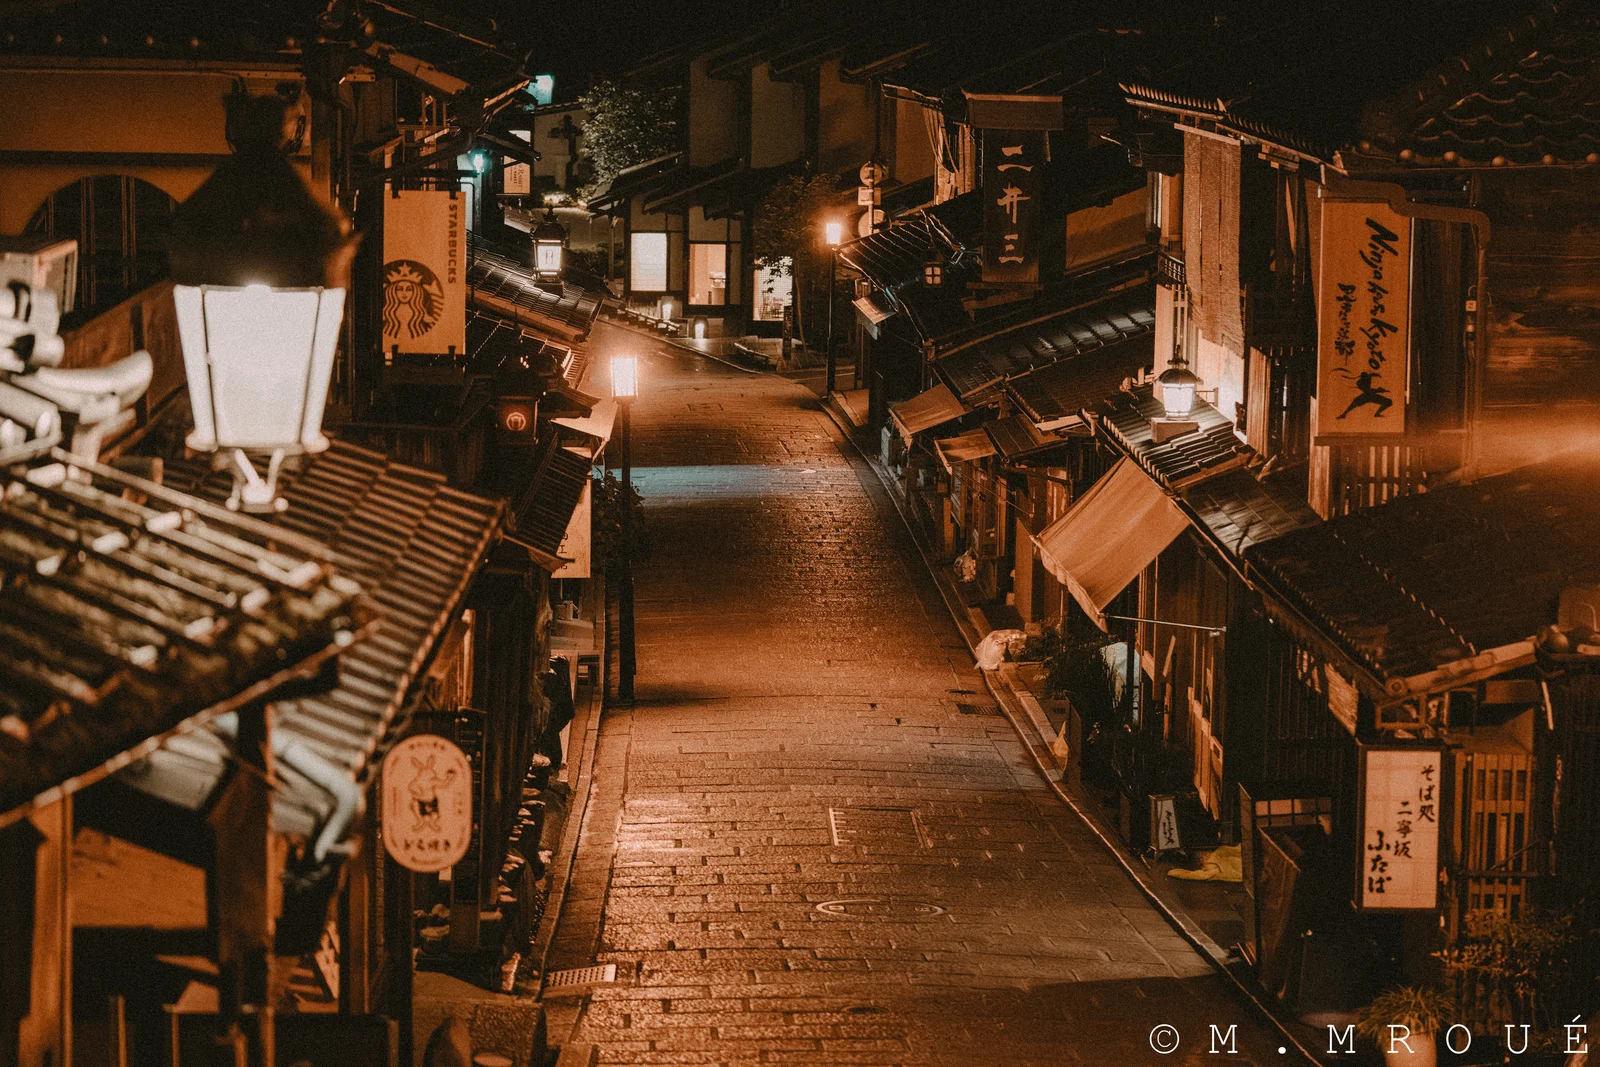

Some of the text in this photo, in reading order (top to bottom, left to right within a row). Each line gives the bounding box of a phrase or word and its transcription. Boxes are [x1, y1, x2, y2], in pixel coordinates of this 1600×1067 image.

[997, 145, 1033, 264] 二井三
[447, 203, 458, 285] STARBUCKS
[1359, 217, 1399, 281] Ninja
[1417, 764, 1436, 823] そば処
[1367, 829, 1393, 894] ふたば
[1393, 801, 1413, 859] 二寧坂
